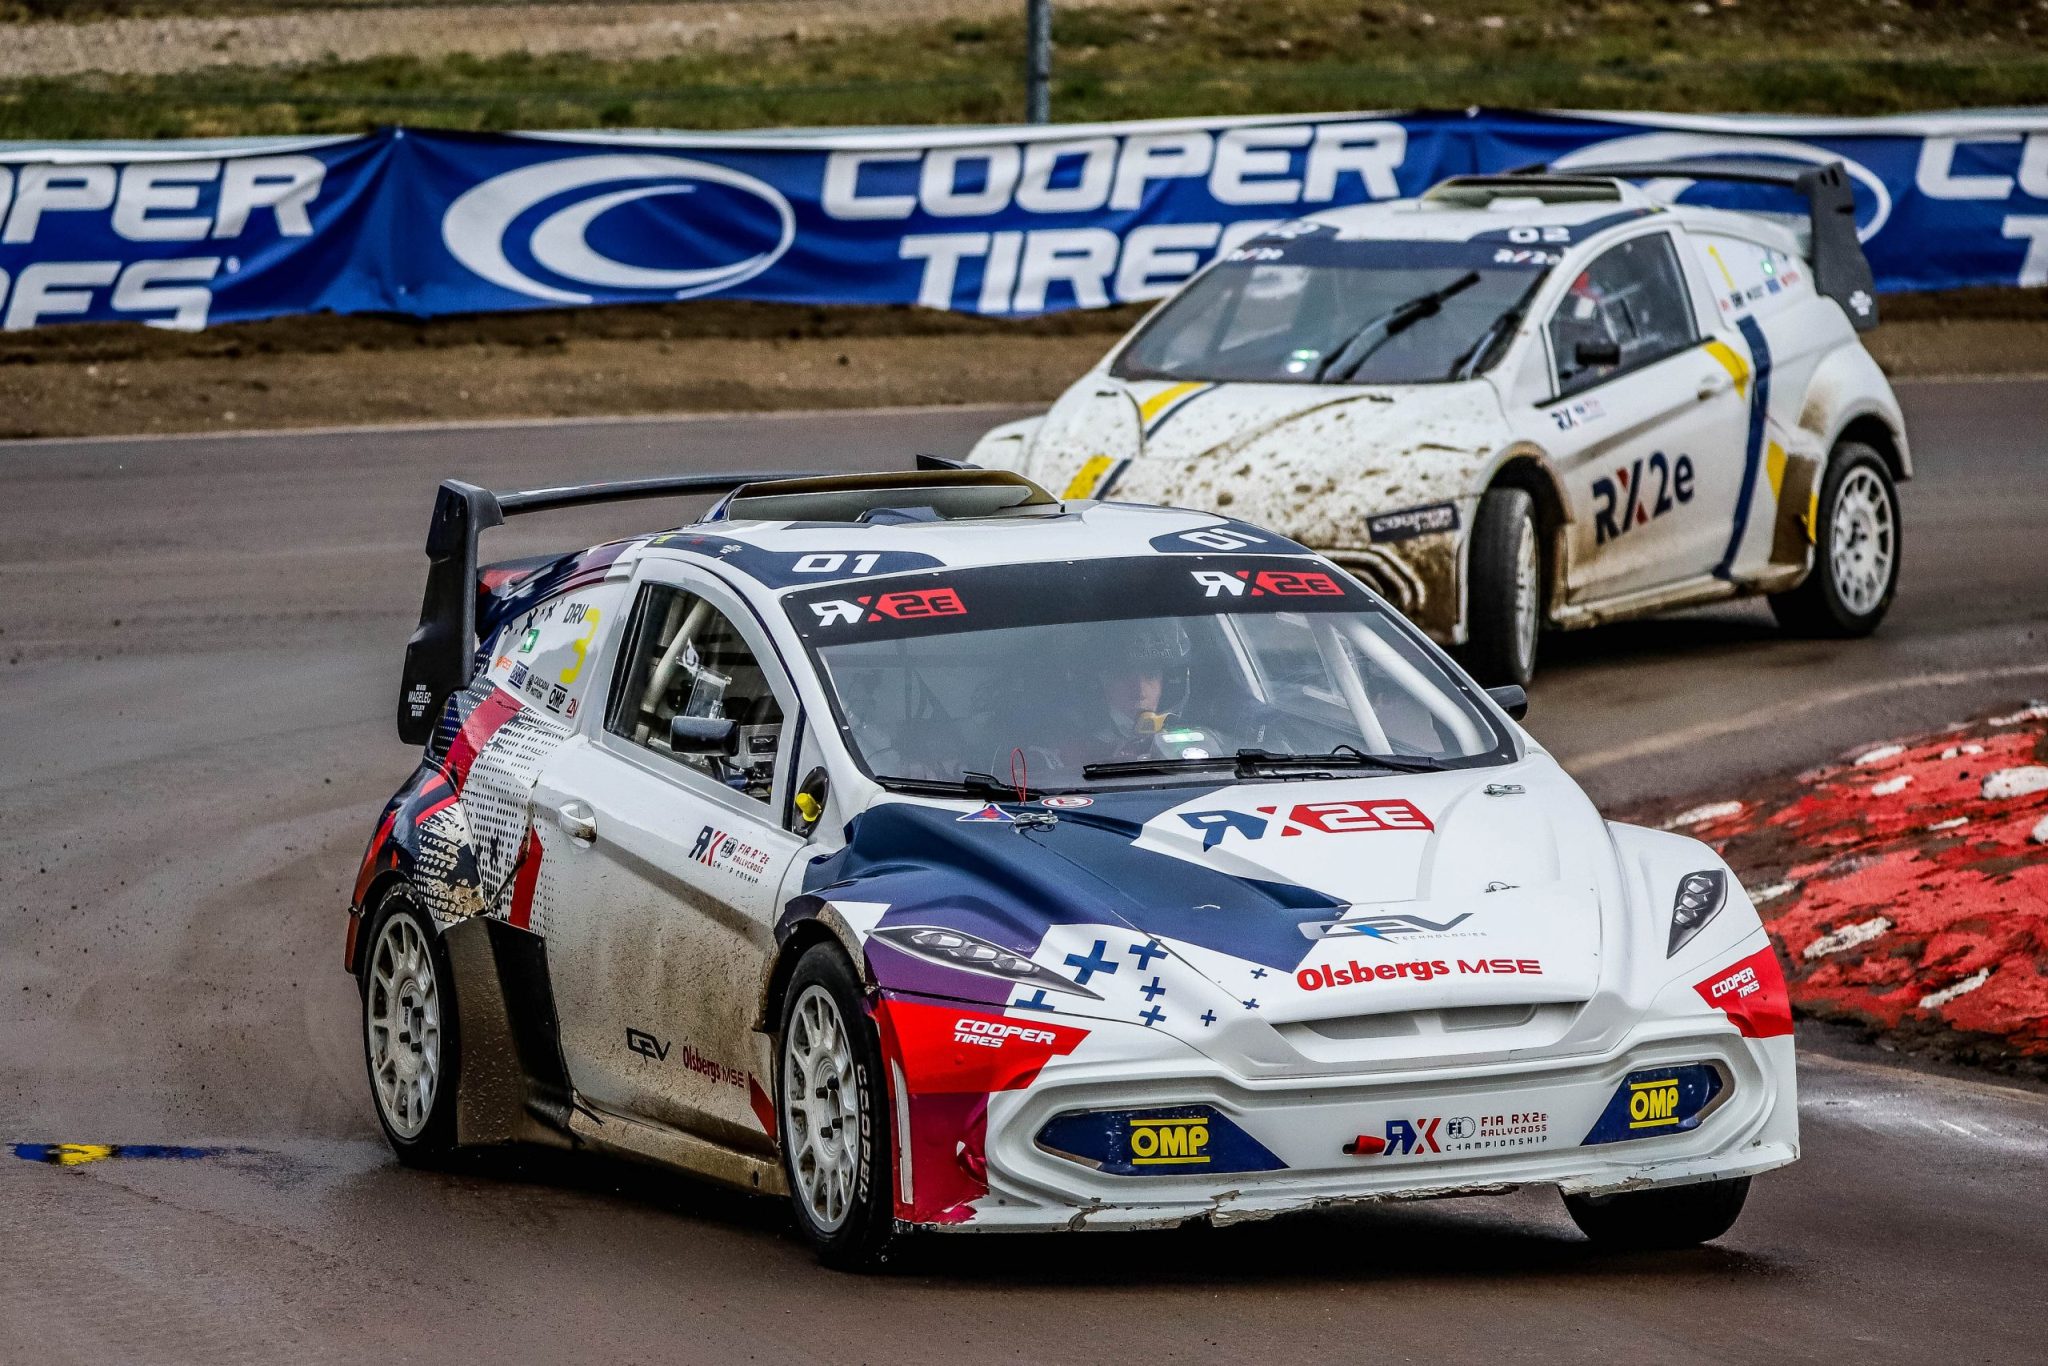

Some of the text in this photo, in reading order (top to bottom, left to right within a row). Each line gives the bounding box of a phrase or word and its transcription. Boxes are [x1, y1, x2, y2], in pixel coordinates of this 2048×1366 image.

[823, 121, 1407, 220] COOPER
[0, 155, 327, 244] PER
[0, 256, 221, 332] ES
[1592, 449, 1694, 545] RX2e
[1178, 527, 1269, 551] 01
[791, 553, 881, 574] 01
[563, 602, 590, 625] DRV
[560, 607, 601, 685] 3
[1296, 958, 1543, 991] Olsbergs MSE
[1711, 966, 1756, 999] COOPER
[1737, 980, 1760, 999] TIRES
[953, 1031, 1005, 1048] TIRES
[954, 1018, 1057, 1046] COOPER
[682, 1045, 745, 1089] Olsbergs MSE
[1630, 1086, 1680, 1121] OMP
[1480, 1123, 1548, 1138] RALLYCROSS
[1481, 1115, 1504, 1127] FIA
[1131, 1125, 1210, 1158] OMP
